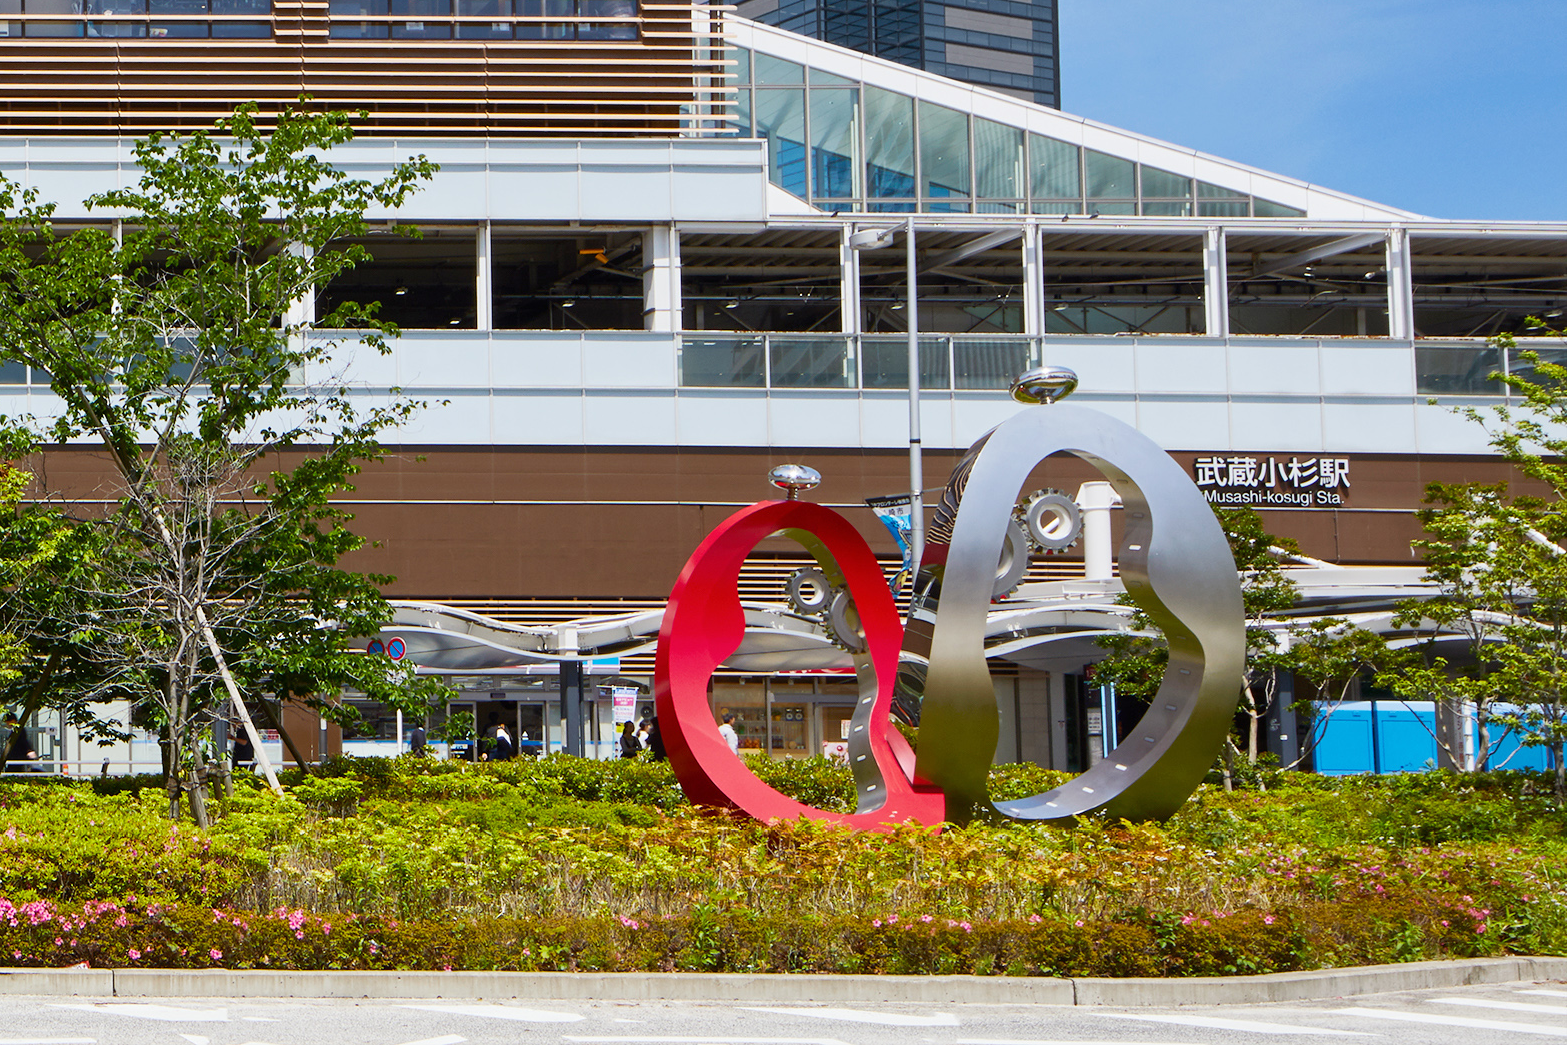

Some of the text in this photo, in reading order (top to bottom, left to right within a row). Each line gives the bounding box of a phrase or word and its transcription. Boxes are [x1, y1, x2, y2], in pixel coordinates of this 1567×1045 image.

[1195, 456, 1351, 488] 武蔵小杉駅
[1204, 490, 1345, 507] Musashi-kosugi Sta.
